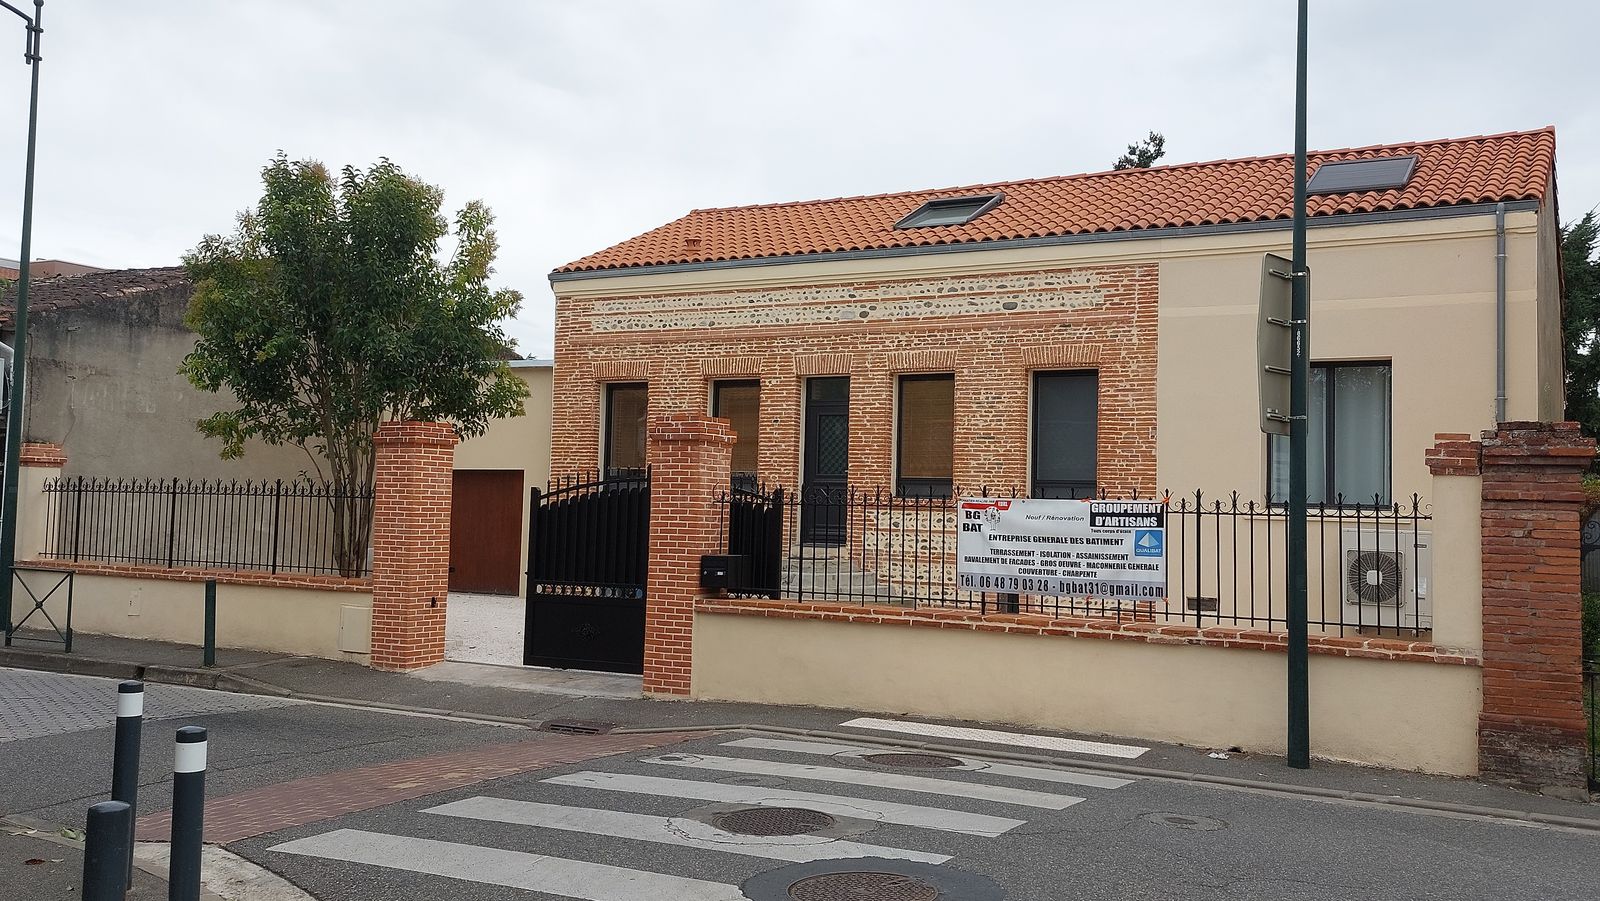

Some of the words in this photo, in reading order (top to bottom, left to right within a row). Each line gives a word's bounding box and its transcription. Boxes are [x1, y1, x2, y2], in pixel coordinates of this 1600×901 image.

[1091, 503, 1163, 514] GROUPEMENT
[965, 510, 981, 520] BG
[1095, 516, 1158, 527] D'ARTISANS
[962, 522, 983, 533] BAT
[988, 534, 1032, 543] ENTREPRISE
[1033, 536, 1068, 544] GENERALE
[1069, 537, 1084, 545] DES
[1086, 538, 1124, 546] BATIMENT
[990, 548, 1035, 557] TERRASSEMENT
[1040, 550, 1071, 559] ISOLATION
[1076, 552, 1129, 560] ASSAINISSEMENT
[964, 556, 1000, 564] RAVALEMENT
[1001, 557, 1007, 565] DE
[1009, 558, 1036, 566] FACADES
[1086, 562, 1127, 570] MACONNERIE
[1128, 563, 1159, 571] GENERALE
[1018, 568, 1058, 576] COUVERTURE
[1062, 570, 1098, 578] CHARPENTE
[960, 574, 977, 587] Tél.
[979, 576, 991, 588] 06
[994, 577, 1005, 589] 48
[1008, 577, 1019, 590] 79
[1022, 578, 1034, 591] 03
[1037, 579, 1049, 592] 28
[1059, 580, 1164, 597] bgbat31@gmail.com
